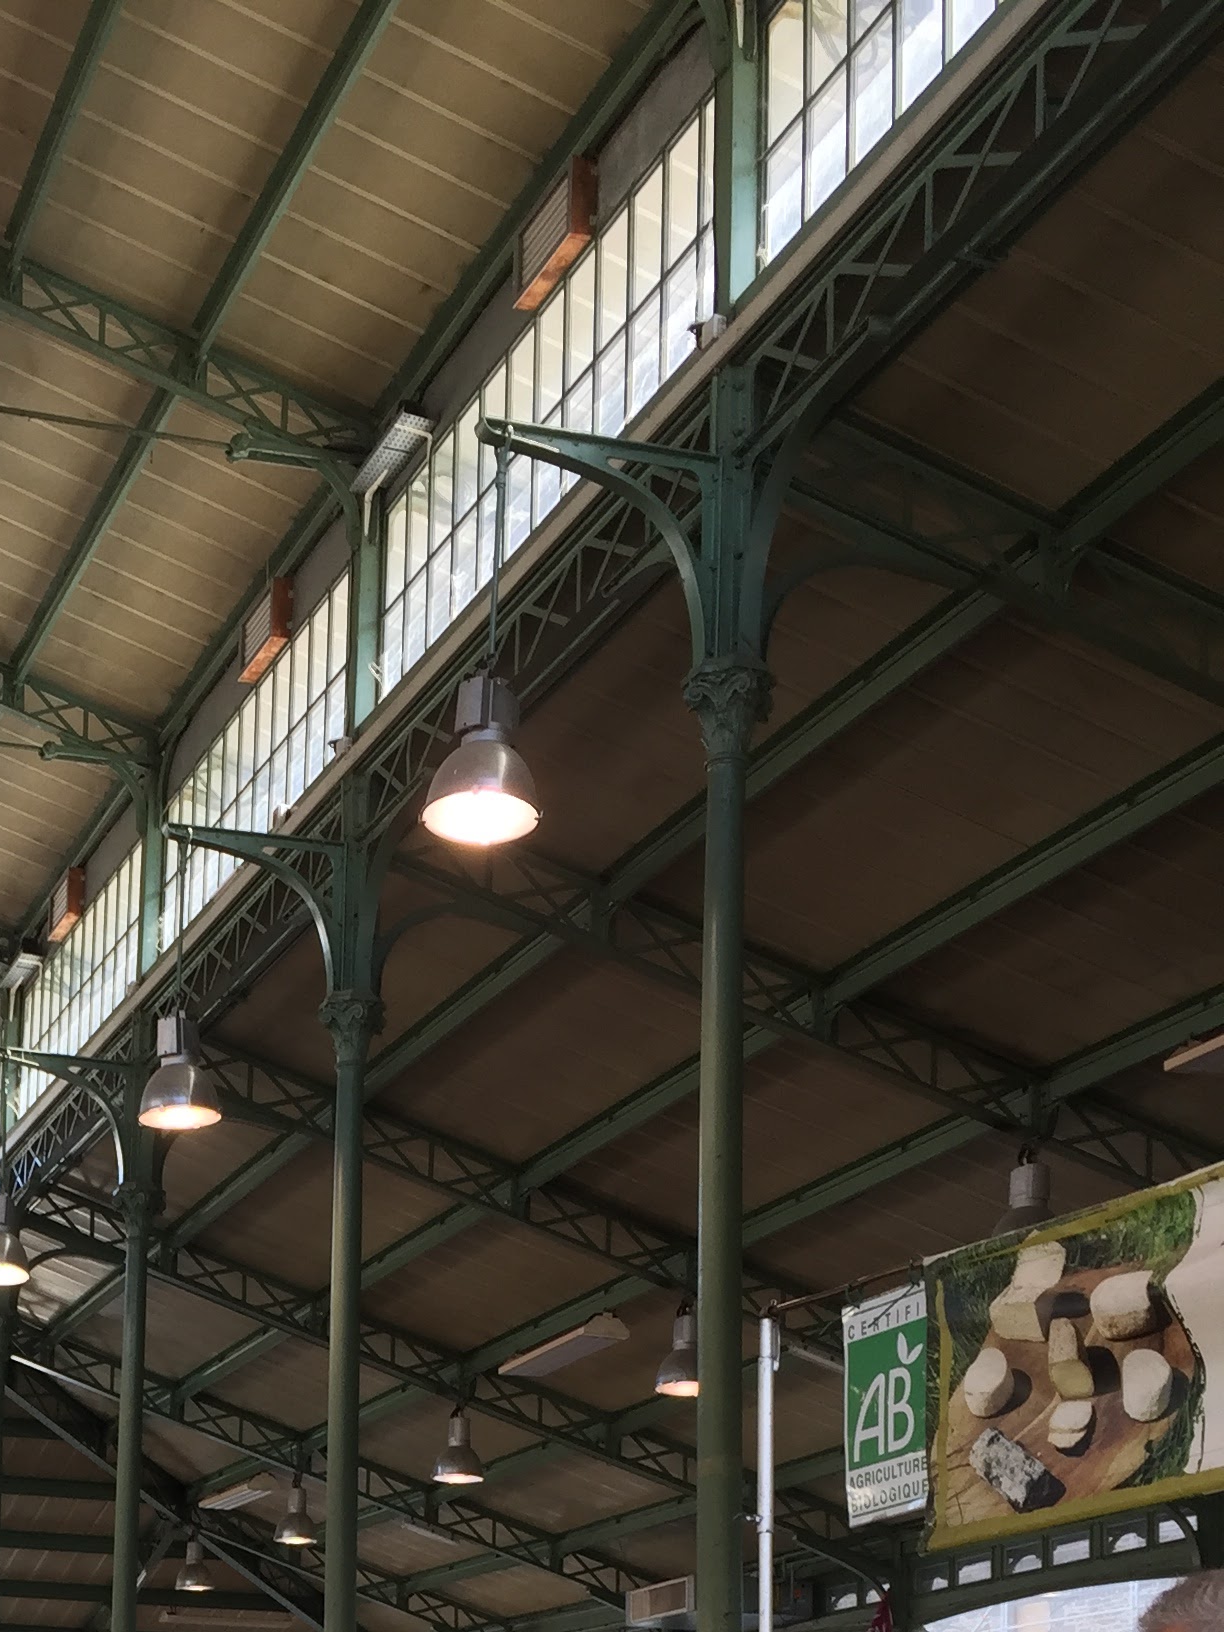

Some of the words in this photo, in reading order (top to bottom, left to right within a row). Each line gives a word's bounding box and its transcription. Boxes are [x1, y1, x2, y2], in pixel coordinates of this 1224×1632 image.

[853, 1367, 915, 1463] AB
[849, 1456, 928, 1490] AGRICULTURE
[851, 1479, 929, 1514] BIOLOGIQUE
